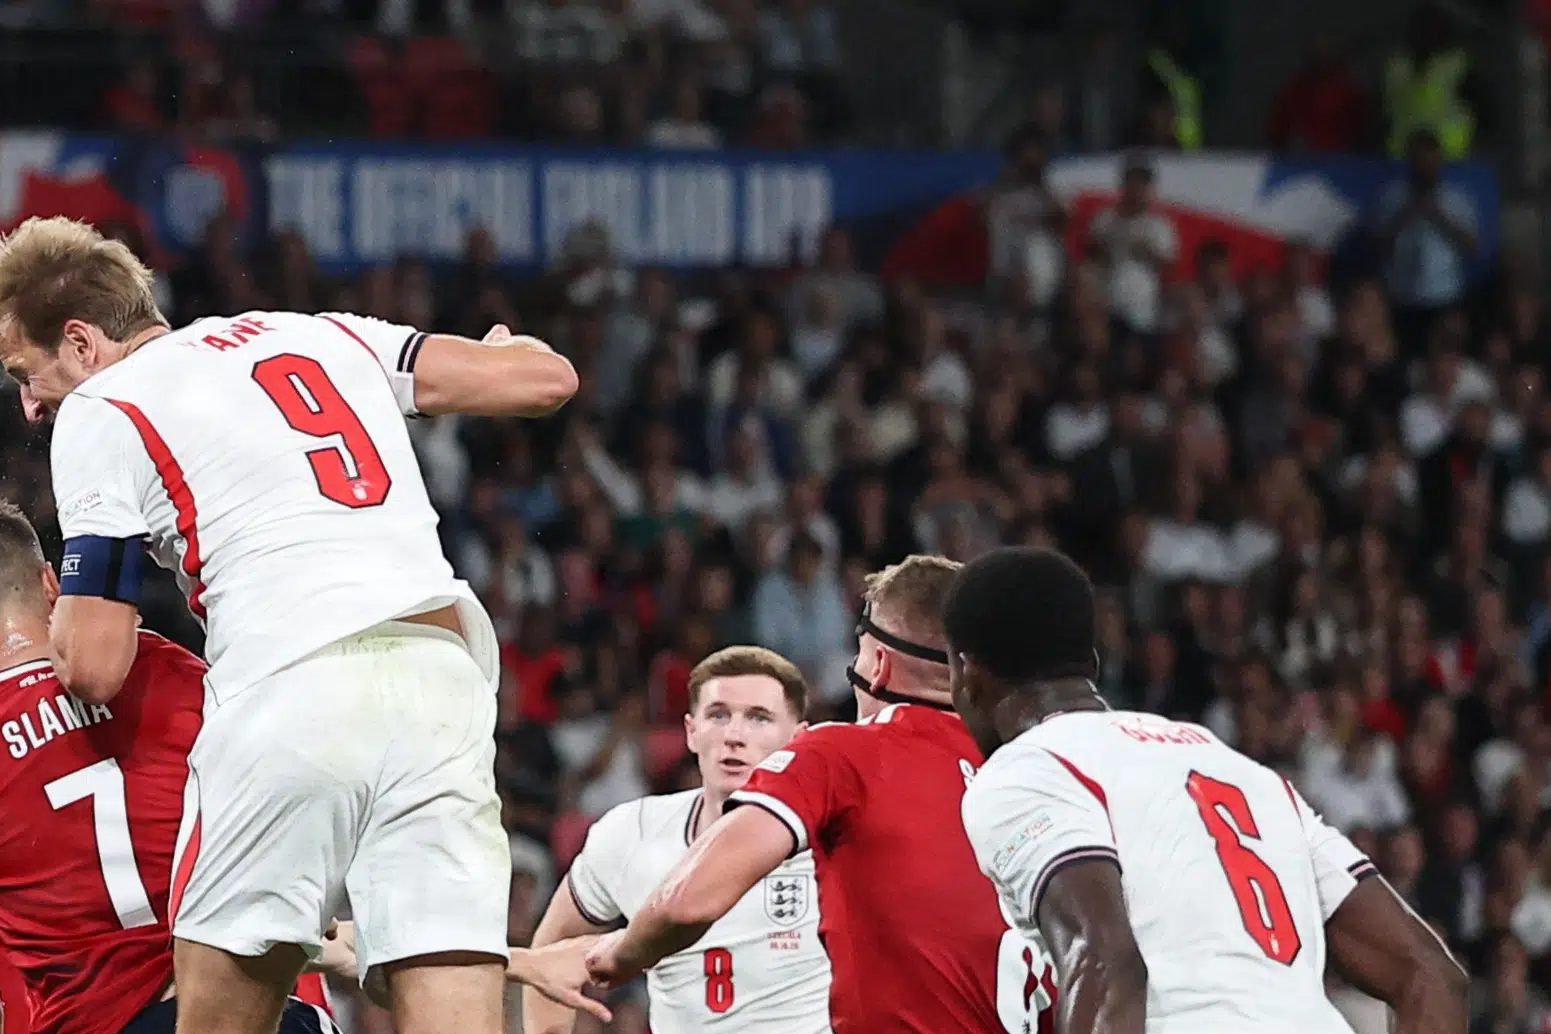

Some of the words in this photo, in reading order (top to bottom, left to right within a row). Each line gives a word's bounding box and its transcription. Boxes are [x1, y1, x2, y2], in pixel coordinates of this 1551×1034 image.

[179, 316, 277, 351] ANE
[251, 353, 392, 508] 9
[44, 757, 158, 930] 7
[1185, 769, 1302, 966] 6
[703, 947, 734, 1013] 8
